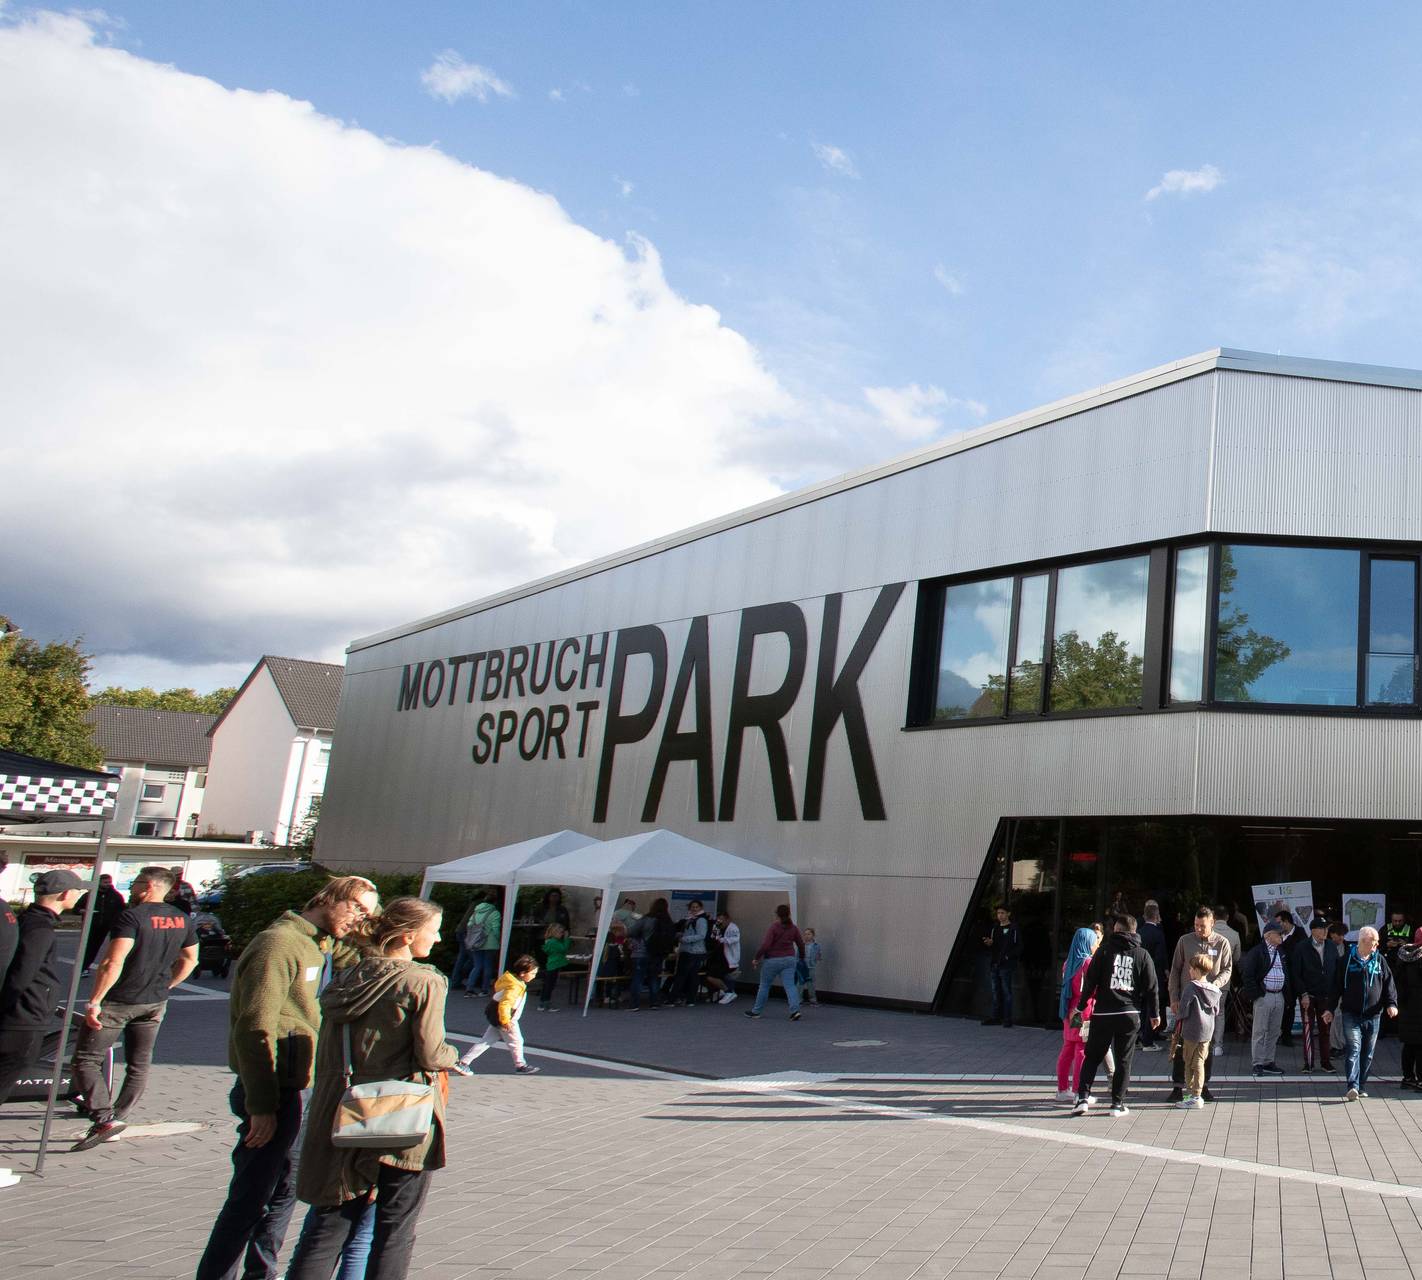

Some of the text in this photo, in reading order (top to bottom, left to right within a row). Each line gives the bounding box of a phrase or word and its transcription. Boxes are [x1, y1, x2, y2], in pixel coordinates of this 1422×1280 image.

[397, 631, 610, 712] MOTTBRUCH
[593, 581, 906, 823] PARK
[472, 701, 600, 765] SPORT
[151, 916, 185, 929] TEAM
[1112, 965, 1133, 979] JOR
[1113, 954, 1134, 968] AIR
